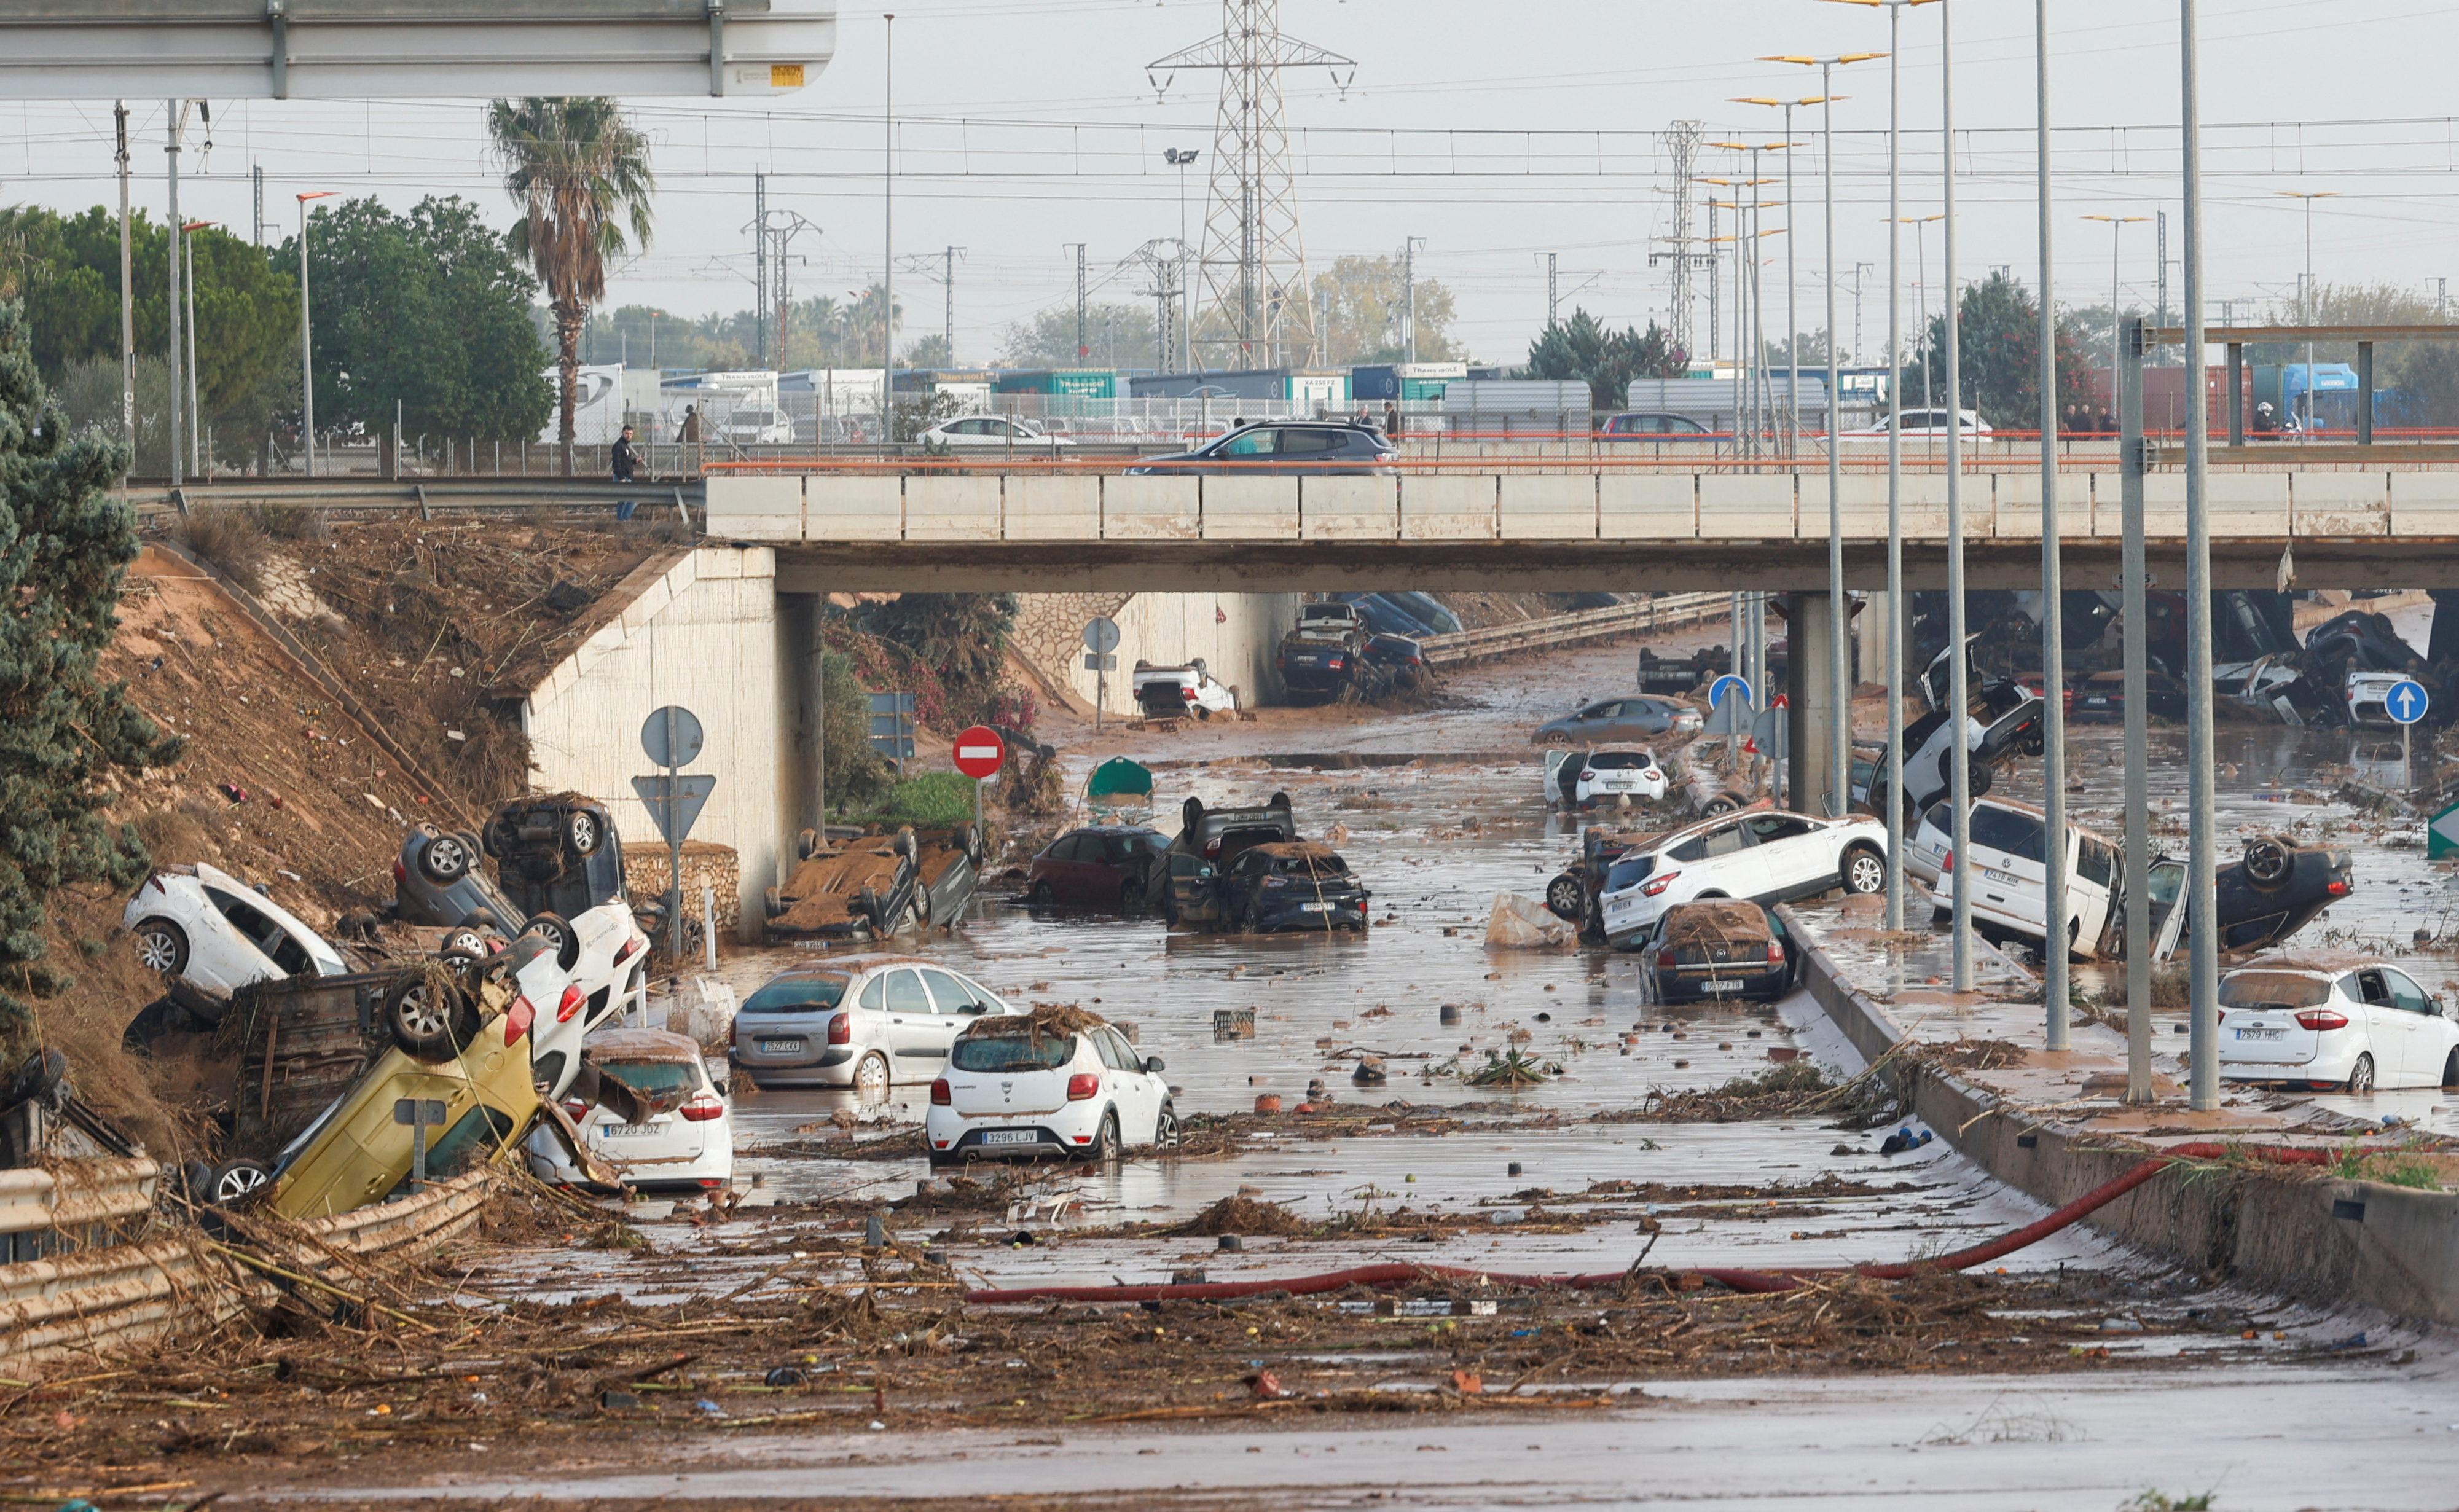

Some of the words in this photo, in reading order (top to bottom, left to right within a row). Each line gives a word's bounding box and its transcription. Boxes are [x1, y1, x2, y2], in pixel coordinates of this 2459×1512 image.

[938, 372, 962, 380] TRANS
[2242, 1030, 2261, 1040] 7579
[2264, 1030, 2280, 1040] HHC
[611, 1124, 637, 1135] 6720
[989, 1133, 1013, 1143] 3296
[1016, 1132, 1034, 1141] LJV
